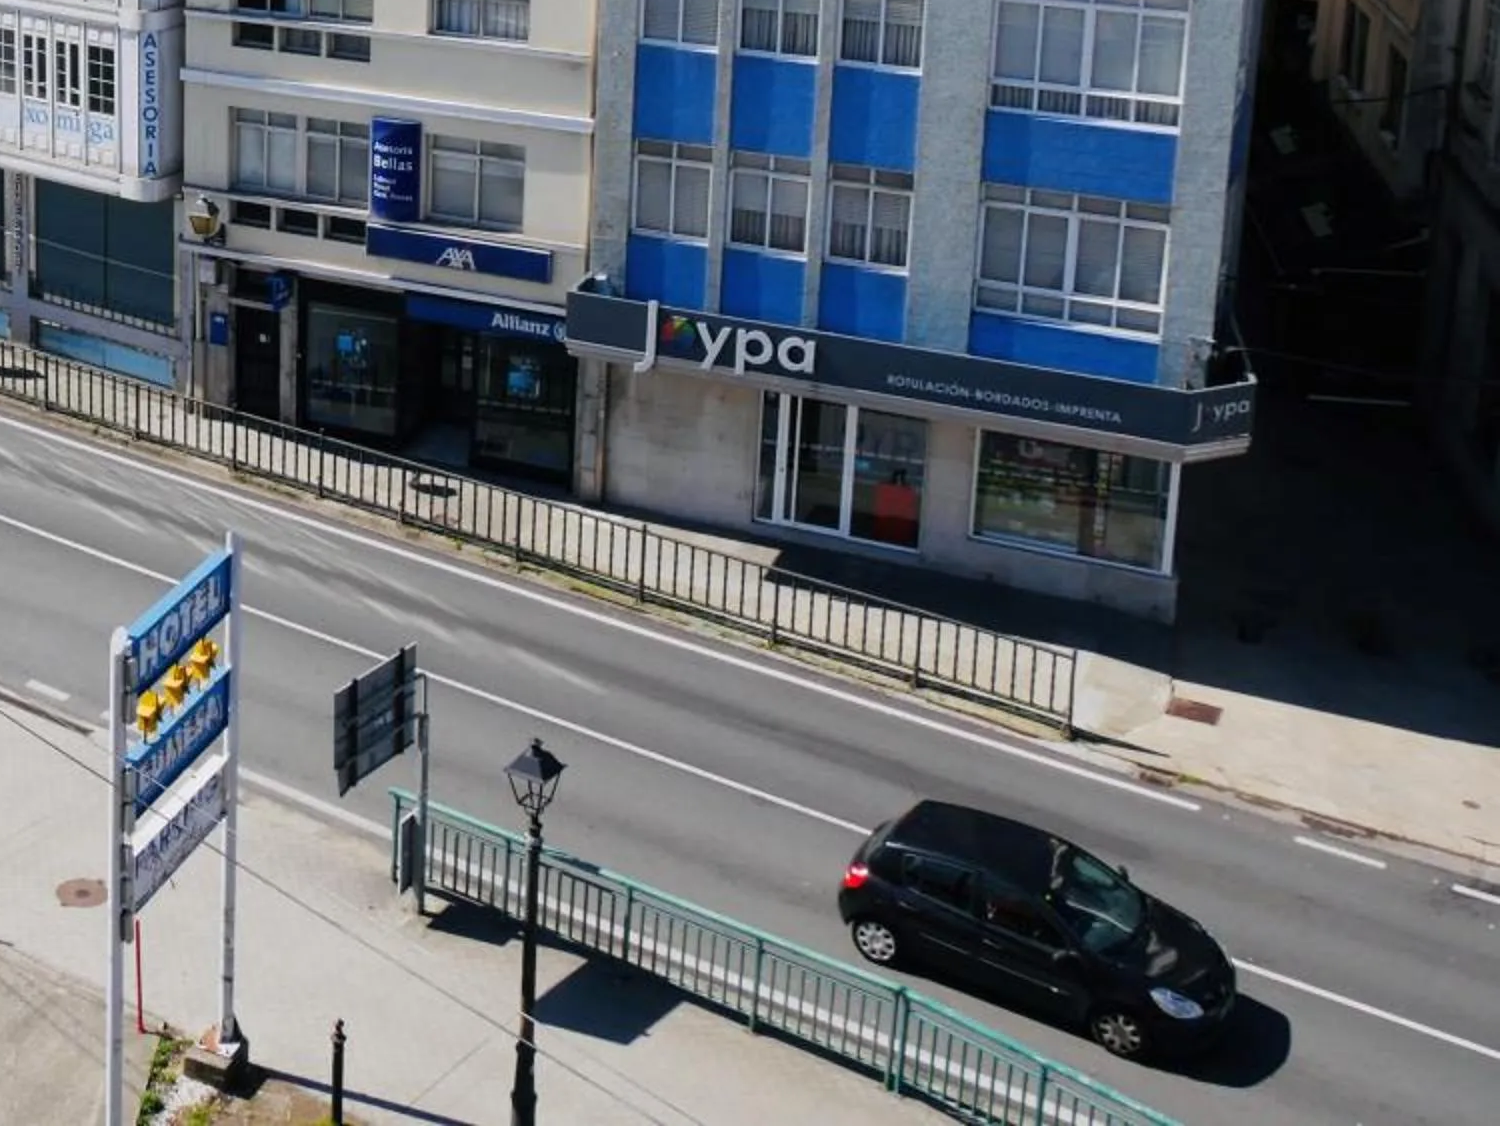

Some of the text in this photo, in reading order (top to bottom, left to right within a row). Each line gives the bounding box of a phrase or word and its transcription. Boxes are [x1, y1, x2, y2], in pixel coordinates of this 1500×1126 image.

[143, 33, 158, 175] ASESORIA
[373, 153, 413, 171] Bellas
[436, 247, 477, 271] AXA
[491, 311, 550, 337] Allianz
[139, 574, 225, 679] HOTEL
